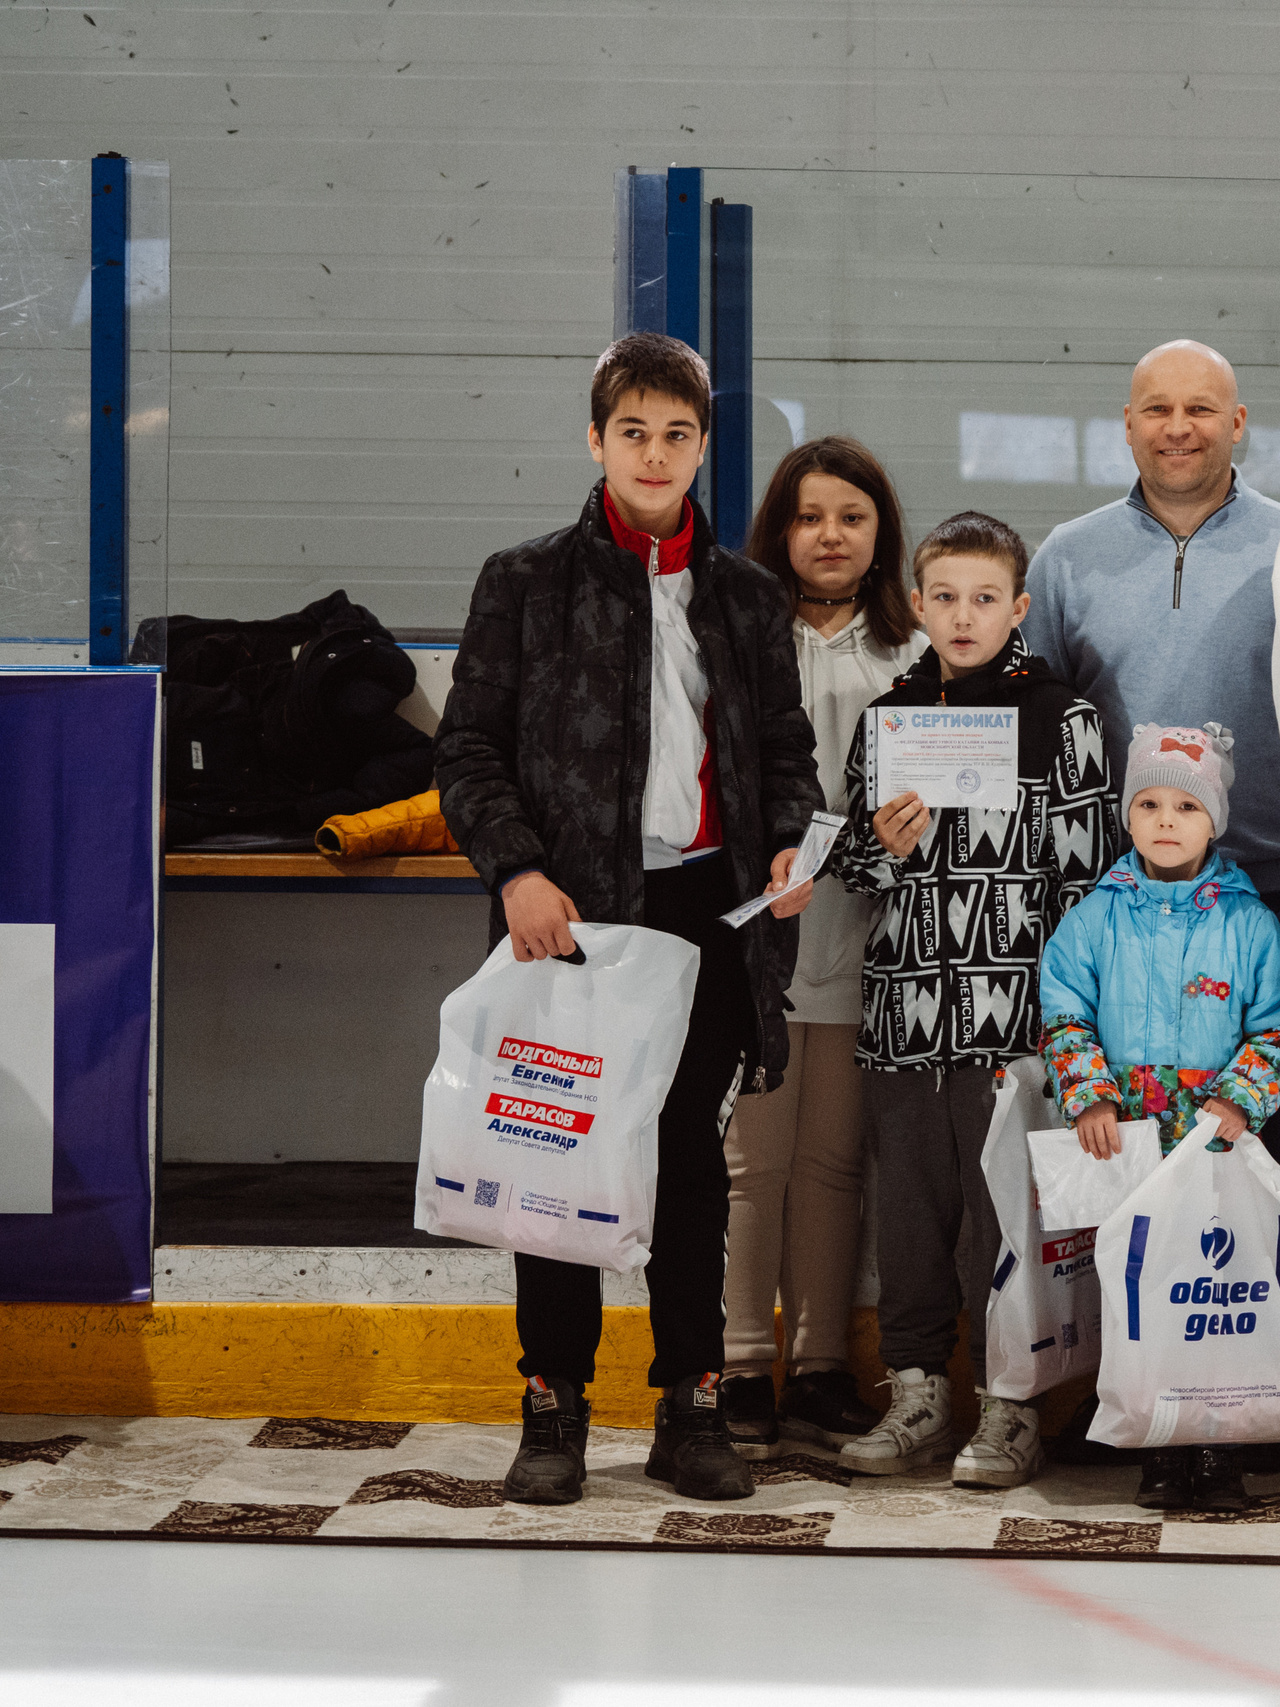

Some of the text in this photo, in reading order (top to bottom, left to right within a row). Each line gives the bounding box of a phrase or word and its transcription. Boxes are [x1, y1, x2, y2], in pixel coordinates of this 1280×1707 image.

[912, 714, 1014, 728] СЕРТИФИКАТ
[1060, 721, 1079, 790] MENCLOR
[958, 807, 968, 864] ENCLOR
[1030, 796, 1040, 864] MENCLOR
[921, 888, 934, 958] MENCLOR
[994, 884, 1008, 954] MENCLOR
[892, 983, 906, 1053] MENCLOR
[958, 976, 972, 1045] MENCLOR
[499, 1098, 576, 1128] ТАРАСОВ
[584, 1094, 598, 1102] НСО
[487, 1118, 578, 1151] Александр
[1170, 1276, 1270, 1307] общее
